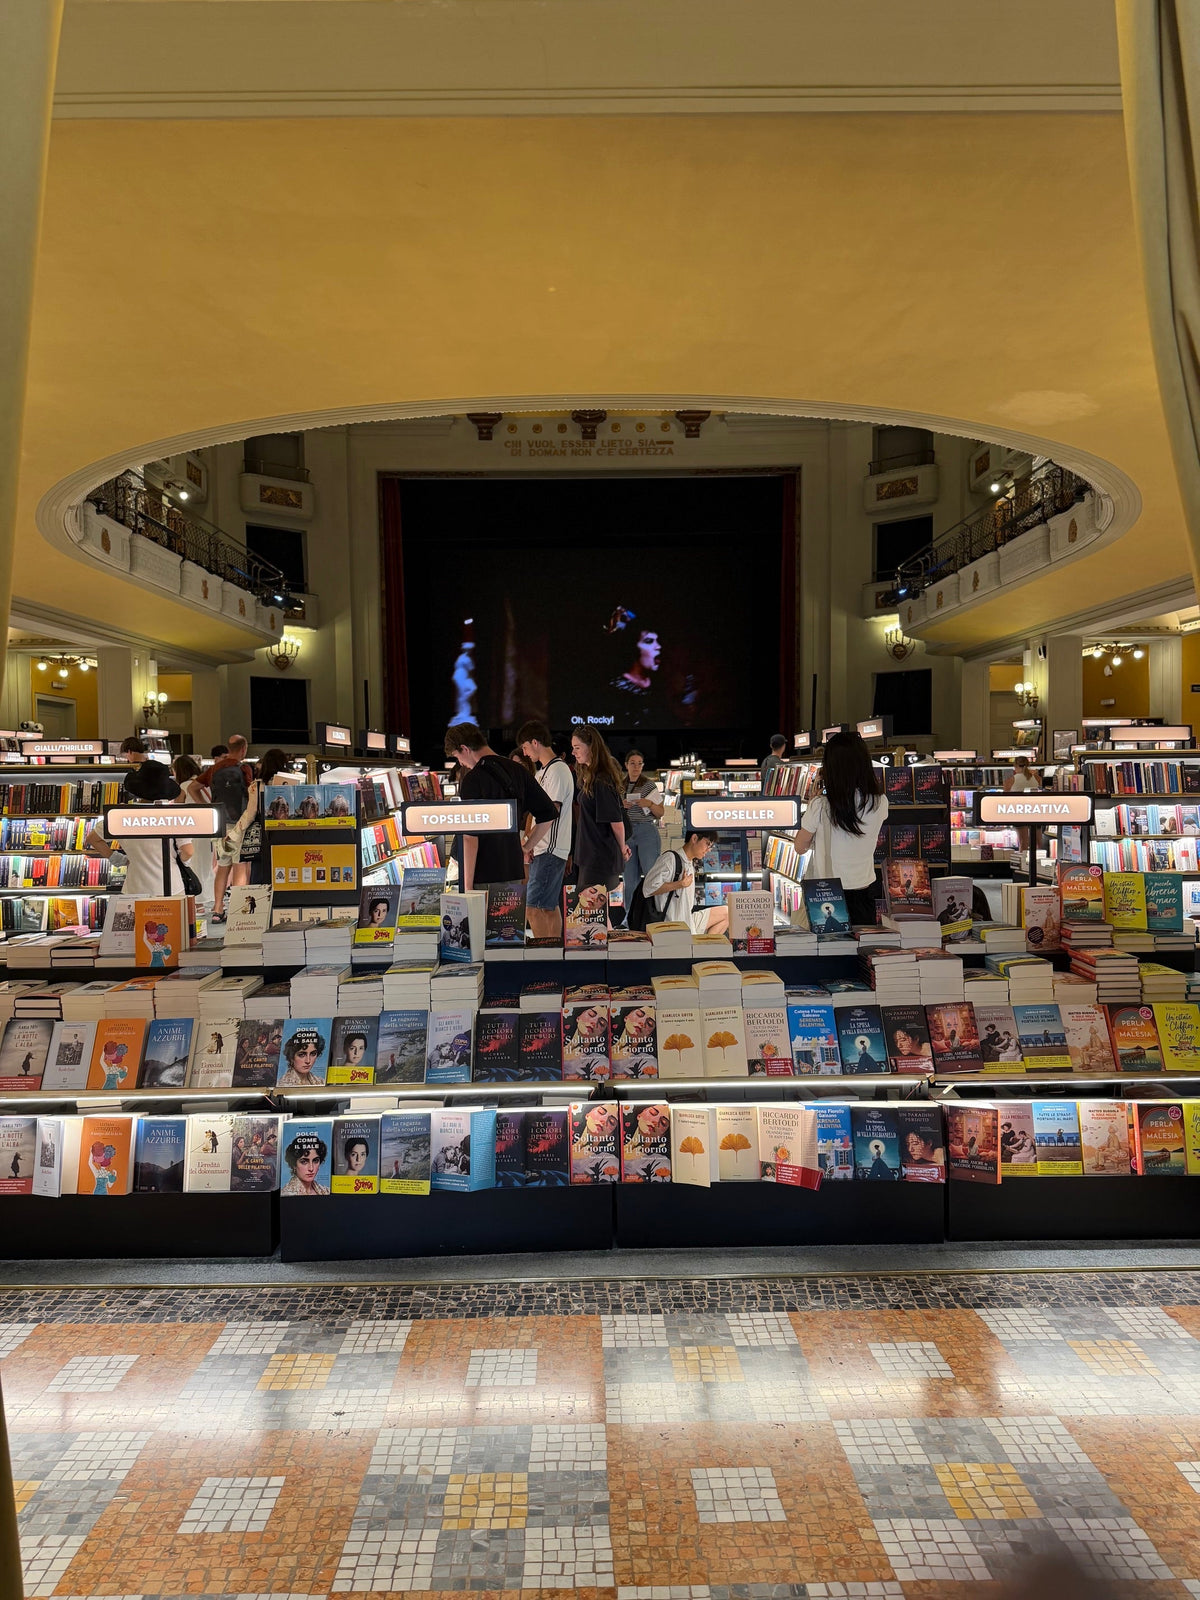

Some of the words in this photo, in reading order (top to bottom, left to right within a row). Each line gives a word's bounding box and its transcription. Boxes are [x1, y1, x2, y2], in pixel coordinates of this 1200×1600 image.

[504, 440, 522, 449] CHI
[528, 440, 556, 449] VUOL
[561, 440, 596, 448] ESSER
[601, 440, 632, 448] LIETO
[510, 448, 522, 456] DI
[529, 448, 567, 456] DOMAN
[571, 448, 592, 456] NON
[618, 448, 674, 456] CERTEZZA
[571, 716, 586, 724] Oh,
[587, 715, 614, 726] Rocky!
[997, 804, 1070, 814] NARRATIVA
[422, 814, 490, 824] TOPSELLER
[706, 810, 774, 820] TOPSELLER
[122, 816, 195, 827] NARRATIVA
[576, 916, 604, 925] giorno
[152, 1034, 186, 1042] AZZURRE
[565, 1036, 606, 1044] Soltanto
[613, 1036, 654, 1044] Soltanto
[575, 1045, 606, 1057] giorno
[622, 1046, 654, 1056] giorno
[763, 1119, 799, 1127] BERTOLDI
[573, 1133, 615, 1142] Soltanto
[625, 1134, 667, 1143] Soltanto
[583, 1144, 615, 1156] giorno
[635, 1144, 668, 1156] giorno
